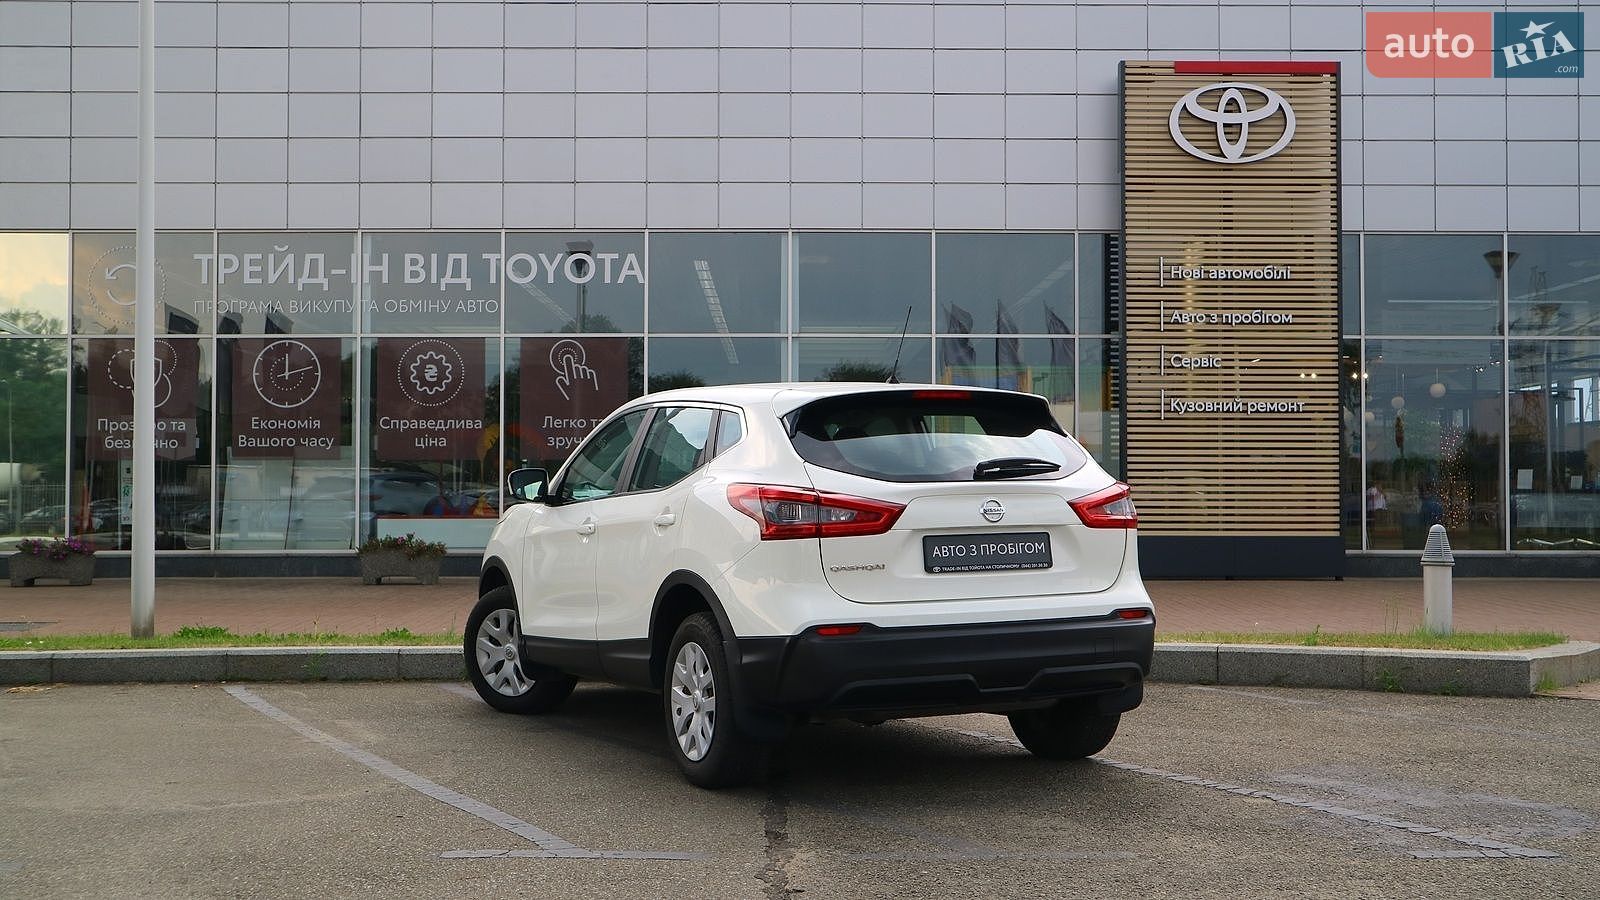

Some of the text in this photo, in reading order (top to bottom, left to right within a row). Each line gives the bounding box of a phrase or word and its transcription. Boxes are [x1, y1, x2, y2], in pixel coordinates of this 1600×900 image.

[193, 245, 645, 291] ТРЕЙД-ІН ВІД TOYOTA
[1170, 266, 1291, 279] Нові автомобілі
[194, 300, 284, 314] ПРОГРАМА
[289, 299, 355, 313] ВИКУПУ
[384, 299, 451, 313] ОБМІНУ
[455, 299, 499, 313] АВТО
[1170, 310, 1293, 327] Авто з пробігом
[1170, 354, 1222, 370] Сервіс
[1170, 398, 1305, 414] Кузовний ремонт
[97, 418, 186, 434] Прозо та
[251, 417, 321, 430] Економія
[379, 416, 483, 430] Справедлива
[542, 415, 603, 429] Легко т
[104, 435, 179, 449] безно
[238, 435, 334, 450] Вашого часу
[415, 434, 447, 448] ціна
[547, 436, 586, 449] зруч
[932, 545, 966, 557] АВТО
[980, 542, 1046, 556] ПРОБІГОМ
[830, 563, 886, 573] QASHQAI
